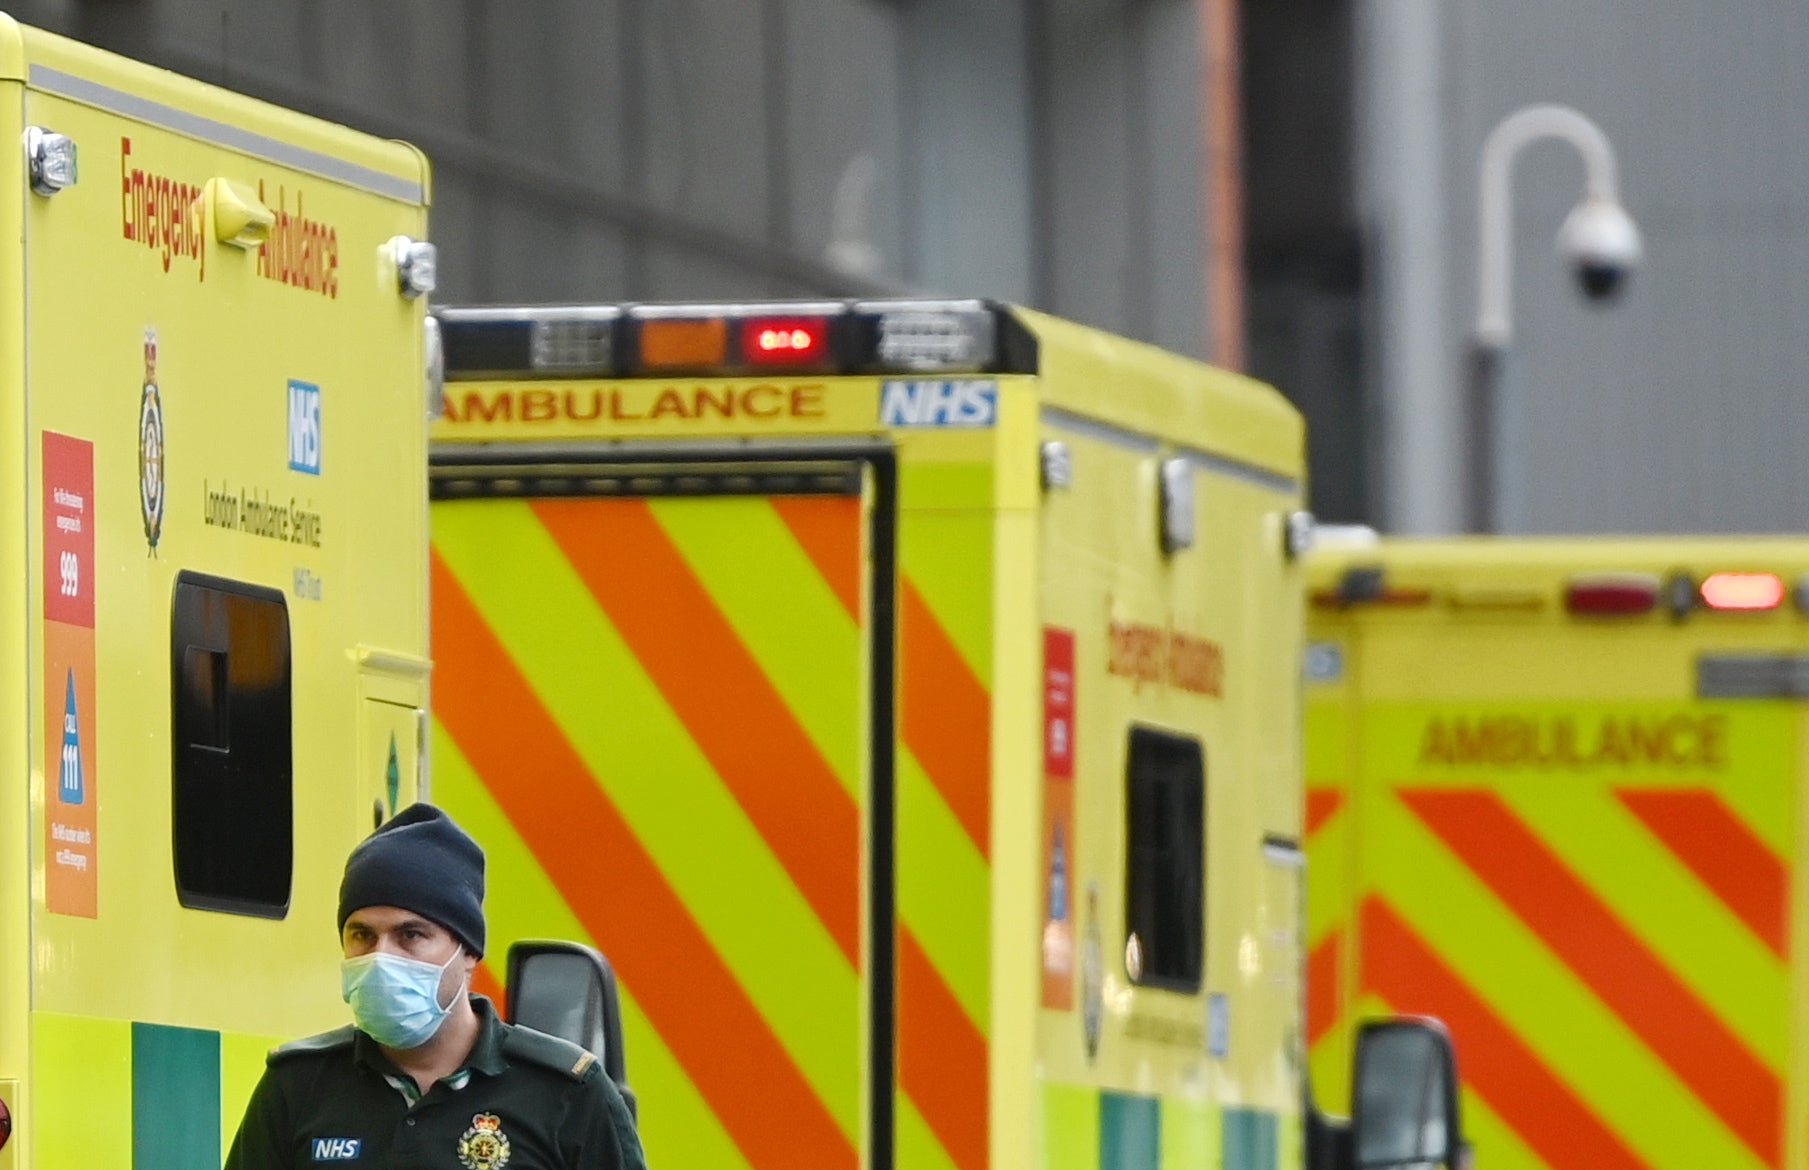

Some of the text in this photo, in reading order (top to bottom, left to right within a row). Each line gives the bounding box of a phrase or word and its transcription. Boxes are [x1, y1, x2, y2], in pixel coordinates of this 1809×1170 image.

[121, 136, 338, 300] Emergency Ambulance
[881, 381, 994, 423] NHS
[288, 385, 321, 468] NHS
[203, 477, 321, 549] London Ambulance Service
[60, 550, 79, 597] 999
[63, 743, 78, 790] 111
[315, 1139, 358, 1158] NHS
